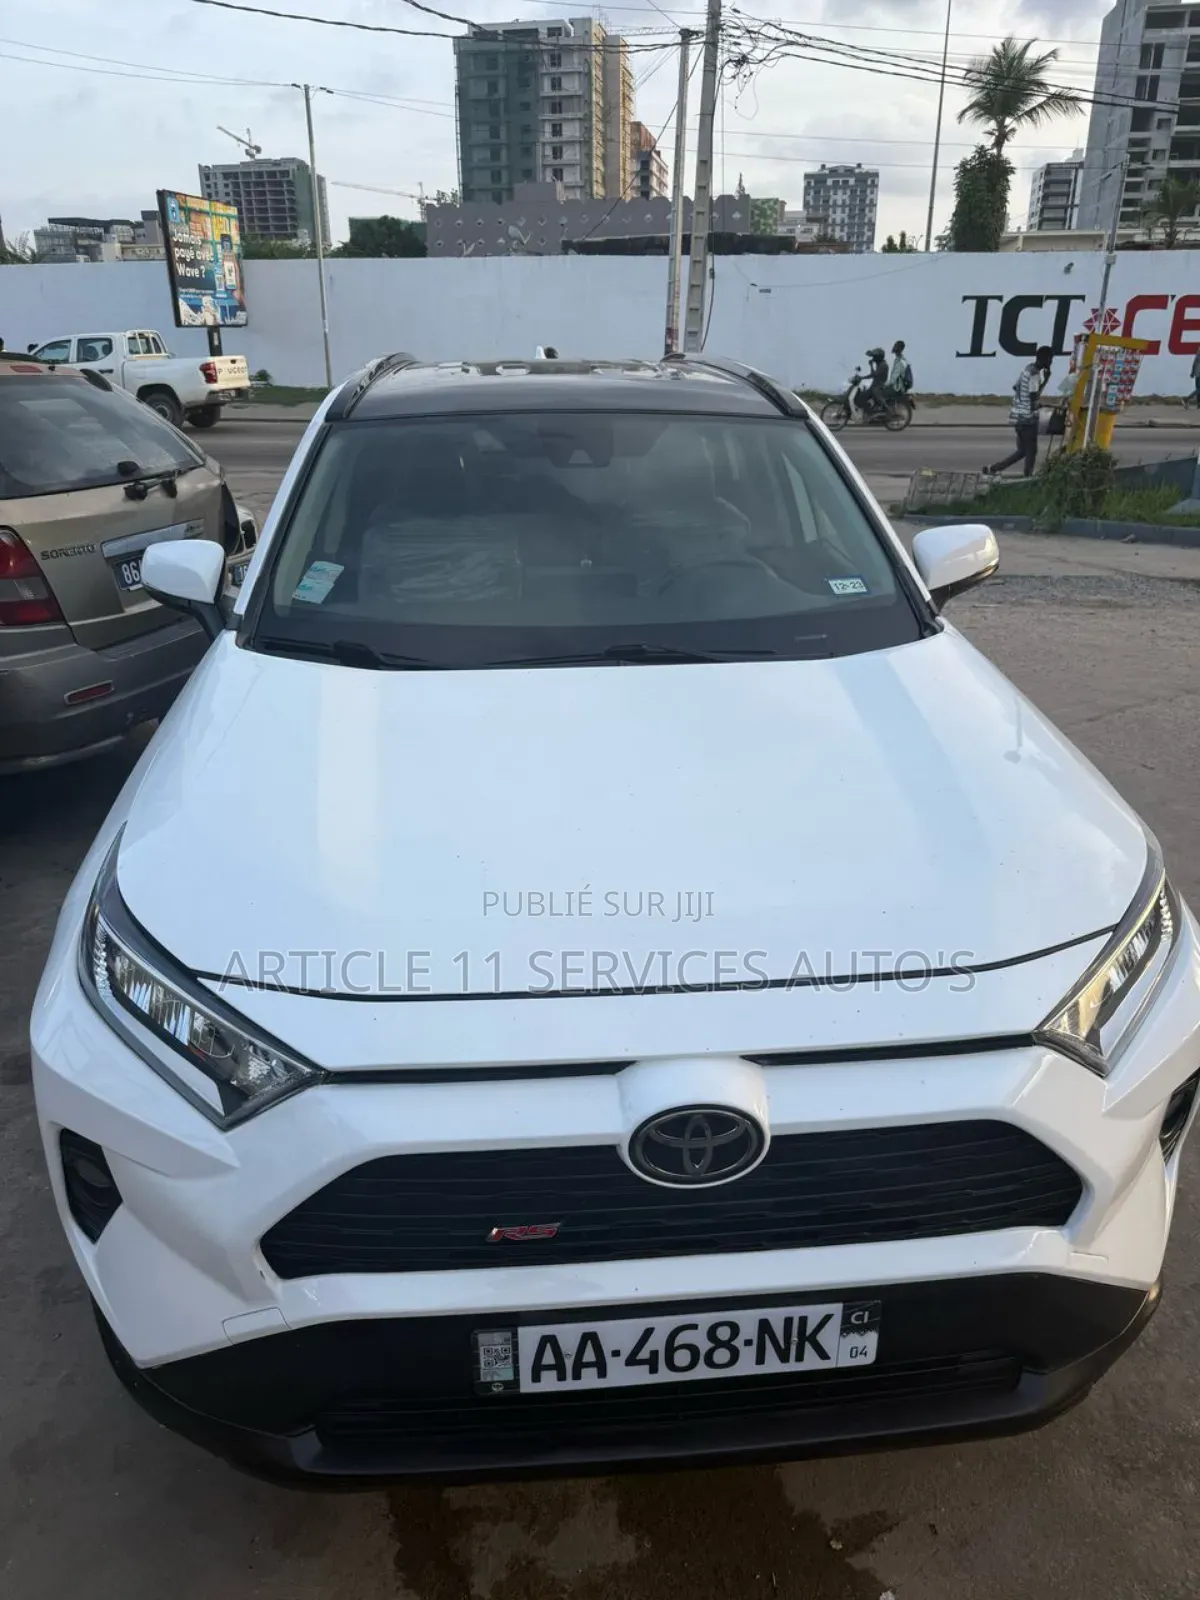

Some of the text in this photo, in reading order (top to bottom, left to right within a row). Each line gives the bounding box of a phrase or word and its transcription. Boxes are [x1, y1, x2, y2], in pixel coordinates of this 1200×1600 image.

[172, 228, 202, 245] Jamais
[174, 247, 215, 262] payé avec
[175, 262, 200, 278] Wave
[851, 1311, 869, 1325] CI
[849, 1345, 868, 1359] 04
